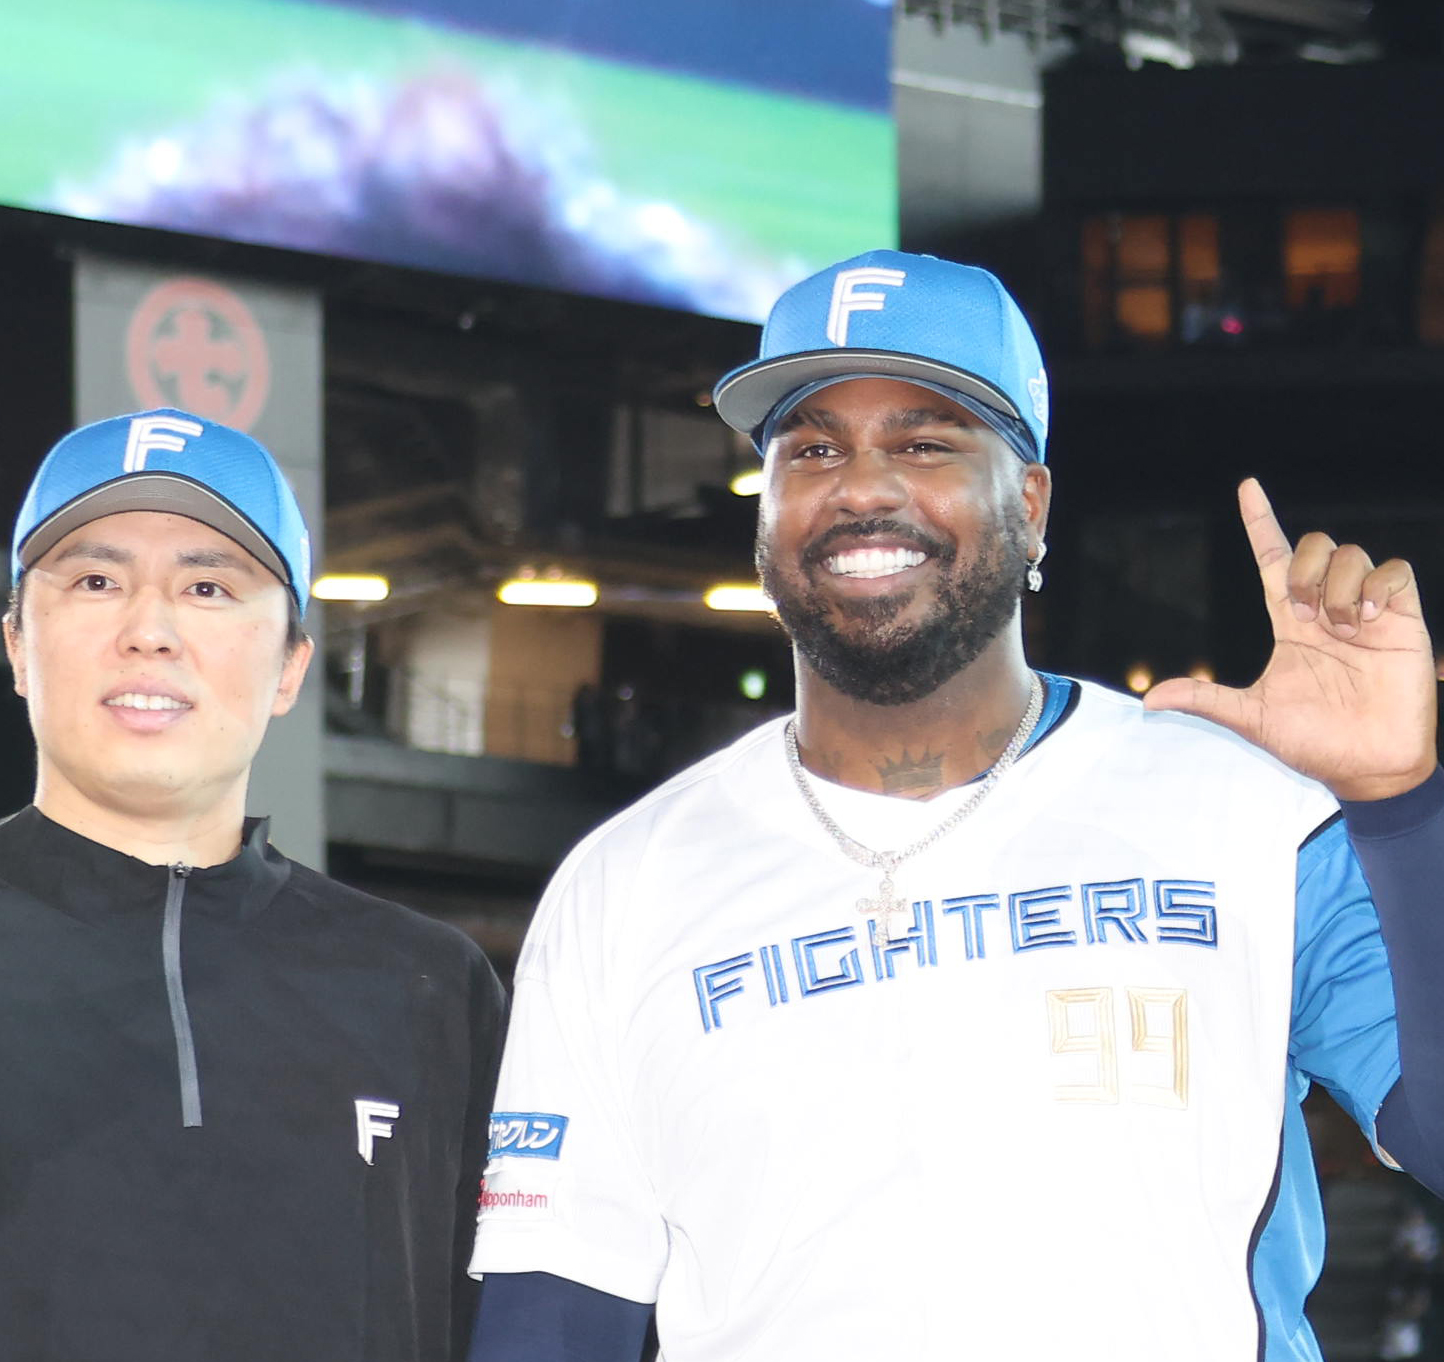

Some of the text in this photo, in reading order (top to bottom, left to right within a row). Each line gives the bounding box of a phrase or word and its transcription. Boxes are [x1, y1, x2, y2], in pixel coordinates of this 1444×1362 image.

[826, 266, 907, 348] F
[122, 416, 203, 473] F
[691, 878, 1219, 1036] FIGHTERS
[1045, 986, 1190, 1110] 99
[355, 1099, 400, 1166] F
